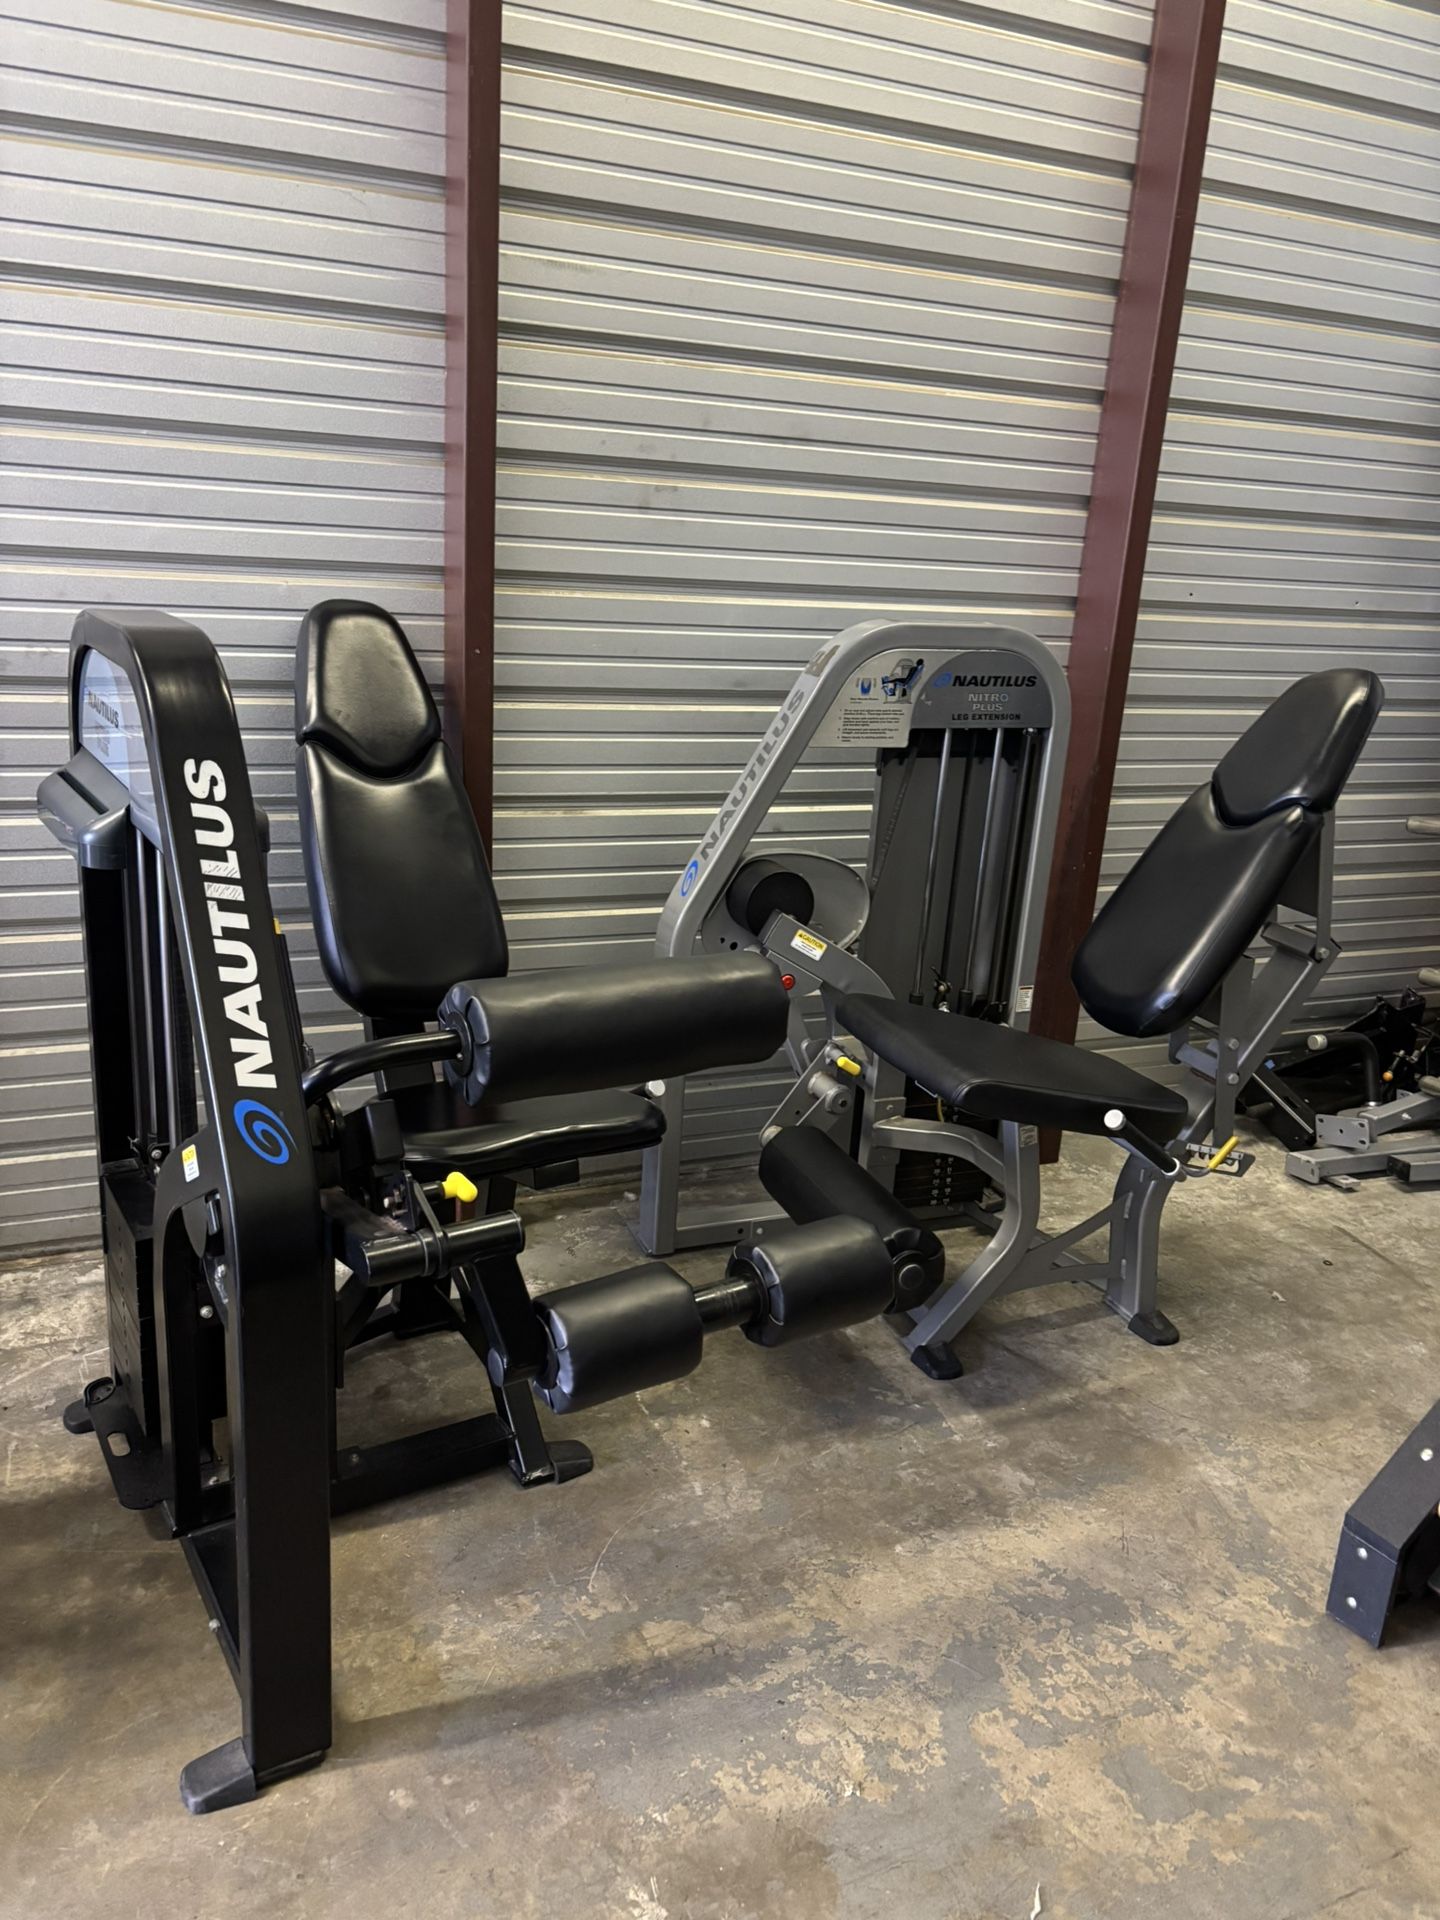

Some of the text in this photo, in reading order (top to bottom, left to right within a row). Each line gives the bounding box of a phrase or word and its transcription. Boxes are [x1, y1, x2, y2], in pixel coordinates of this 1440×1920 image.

[952, 675, 1038, 688] NAUTILUS
[968, 693, 1009, 702] NITRO
[972, 703, 1003, 711] PLUS
[951, 713, 1021, 721] LEG EXTENSION
[700, 688, 805, 861] NAUTILUS
[183, 757, 278, 1089] NAUTILUS
[802, 934, 823, 949] CAUTION
